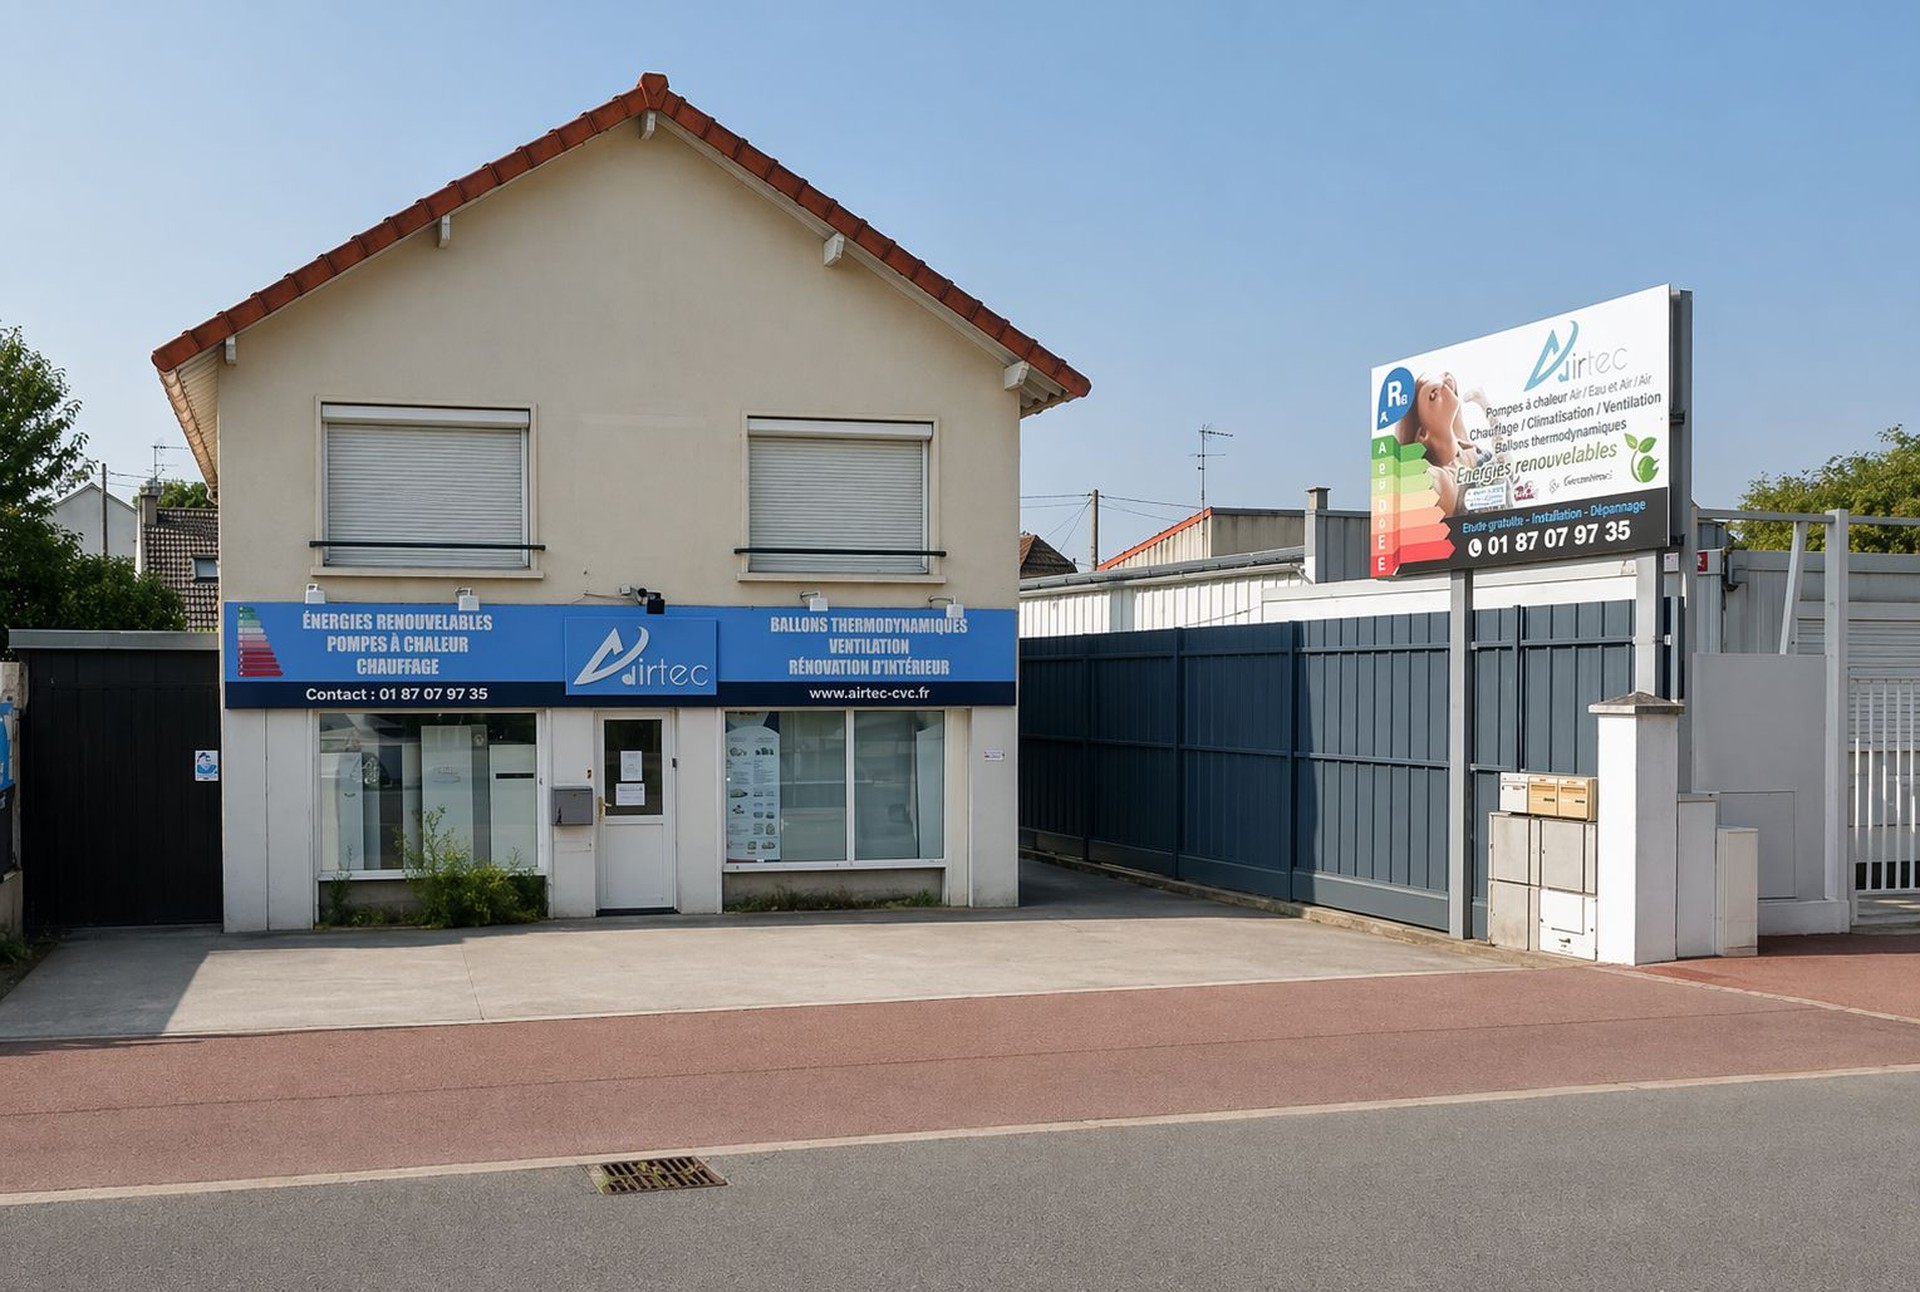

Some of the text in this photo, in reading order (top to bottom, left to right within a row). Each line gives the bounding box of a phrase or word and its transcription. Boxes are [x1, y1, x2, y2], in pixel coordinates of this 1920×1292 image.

[1486, 402, 1524, 418] Pompes
[1533, 392, 1568, 409] chaleur
[1527, 406, 1594, 430] Climatisation
[1603, 392, 1661, 414] Ventilation
[1531, 419, 1627, 447] thermodynamiques
[1515, 442, 1617, 474] renouvelables
[1590, 500, 1646, 518] Dépannage
[1487, 520, 1631, 555] 01 87 07 97 35
[302, 610, 493, 631] ÉNERGIES RENOUVELABLES
[770, 617, 968, 635] BALLONS THERMODYNAMIQUES
[327, 631, 469, 653] POMPES À CHALEUR
[829, 638, 909, 654] VENTILATION
[356, 658, 440, 675] CHAUFFAGE
[789, 656, 950, 675] RÉNOVATION D'INTÉRIEUR
[305, 687, 367, 701] Contact
[379, 687, 396, 701] 01
[400, 687, 420, 701] 87
[424, 687, 443, 701] 07
[446, 687, 466, 701] 97
[469, 687, 489, 701] 35
[809, 685, 931, 700] www.airtec-cvc.fr
